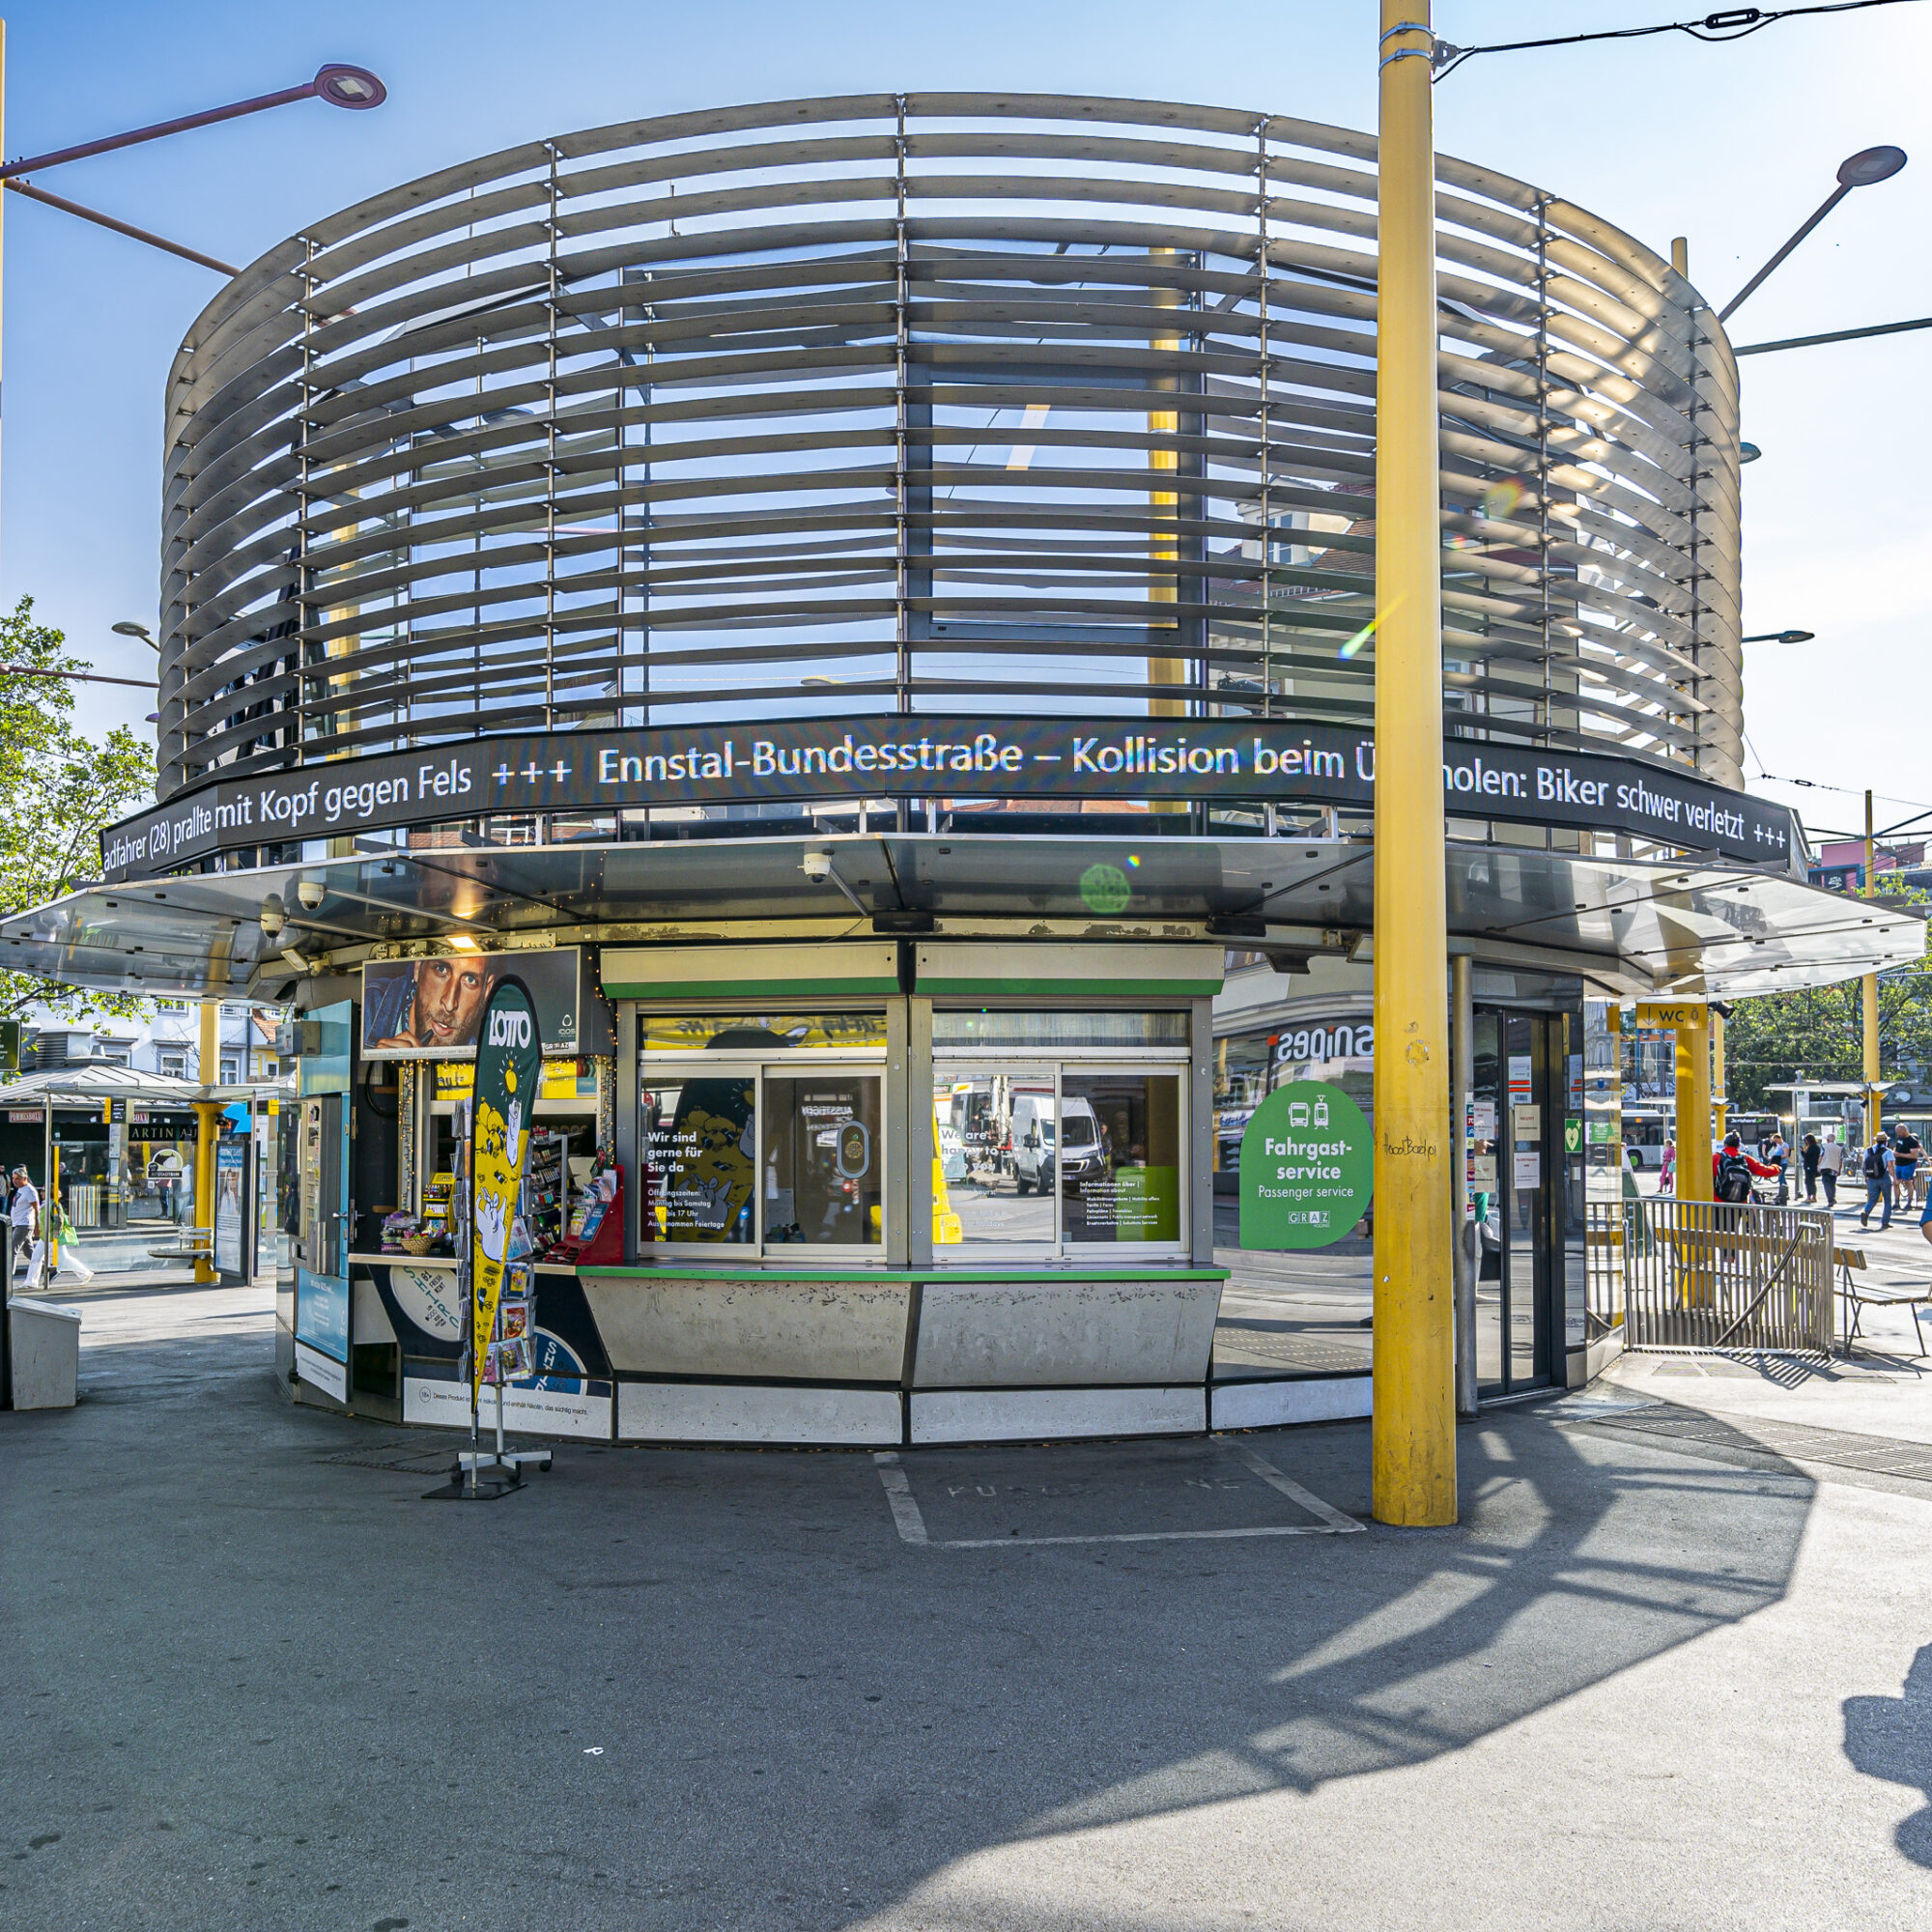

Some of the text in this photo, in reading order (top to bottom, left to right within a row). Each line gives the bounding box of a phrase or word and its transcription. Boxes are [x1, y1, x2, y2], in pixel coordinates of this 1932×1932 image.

[103, 835, 147, 871] adfahrer
[149, 819, 171, 861] (28)
[174, 805, 212, 855] prallte
[214, 794, 253, 829] mit
[260, 781, 320, 828] Kopf
[325, 777, 410, 822] gegen
[418, 759, 472, 800] Fels
[598, 733, 1024, 783] Ennstal-Bundesstraße
[1072, 736, 1240, 775] Kollision
[1254, 737, 1346, 779] beim
[1537, 767, 1610, 807] Biker
[1616, 780, 1681, 823] schwer
[1685, 800, 1745, 840] verletzt
[1659, 1010, 1685, 1022] WC
[488, 1009, 531, 1049] LOTTO
[131, 1127, 174, 1138] ARTIN
[647, 1131, 696, 1143] Wir sind
[647, 1147, 703, 1159] gerne für
[985, 1147, 999, 1155] to
[1264, 1137, 1352, 1161] Fahrgast-
[647, 1161, 684, 1173] Sie da
[972, 1163, 996, 1174] you
[1277, 1162, 1341, 1180] service
[1259, 1185, 1353, 1201] Passenger service
[1290, 1212, 1328, 1223] GRAZ
[695, 1220, 724, 1229] Feiertage
